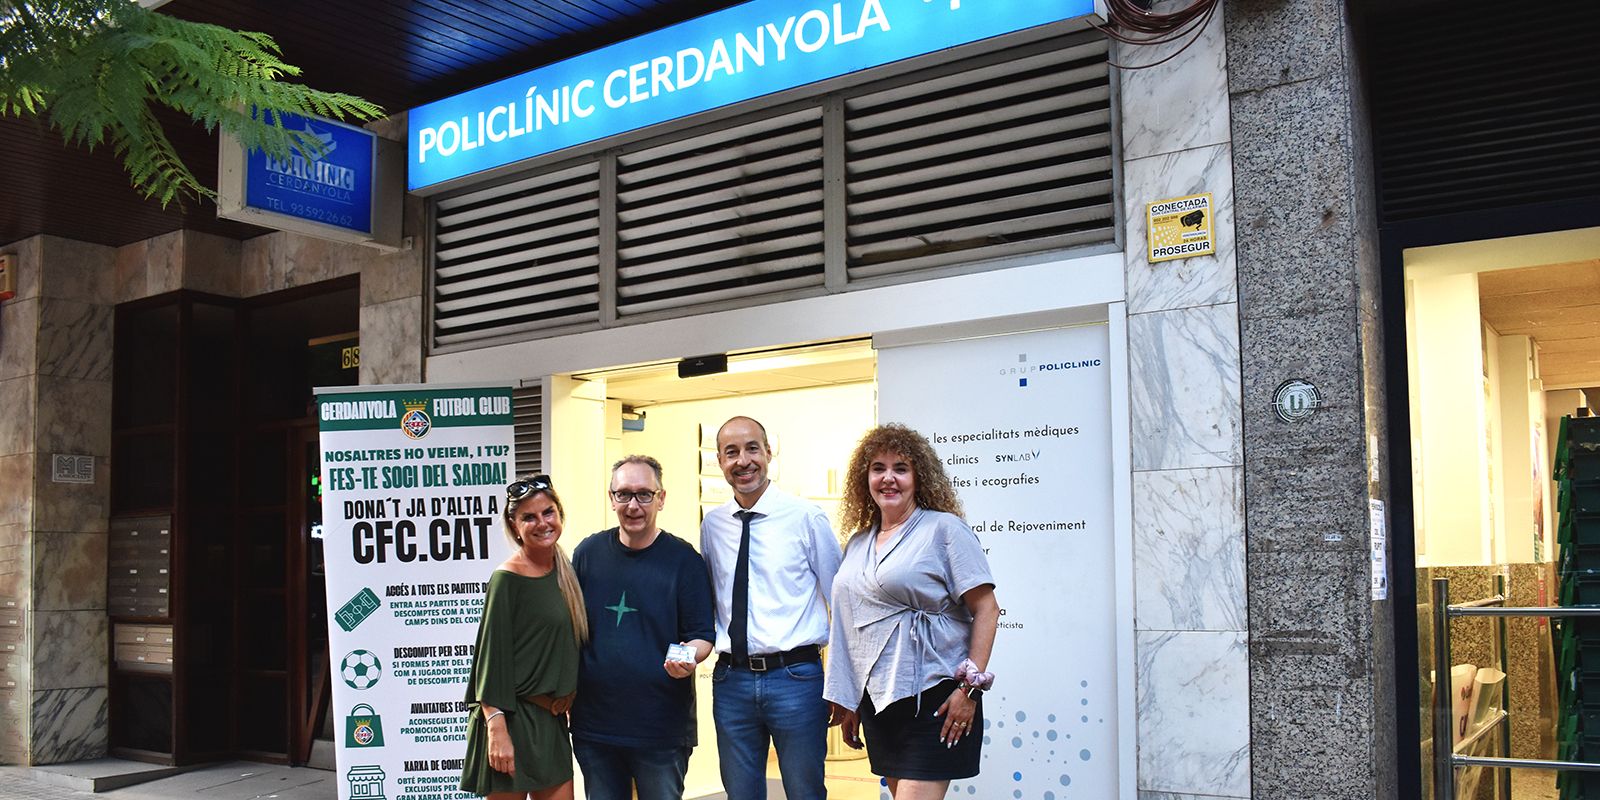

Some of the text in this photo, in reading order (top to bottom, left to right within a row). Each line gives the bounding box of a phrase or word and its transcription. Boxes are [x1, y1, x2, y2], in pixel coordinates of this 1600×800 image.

[418, 0, 891, 164] POLICLÍNIC CERDANYOLA
[269, 172, 352, 201] CERDANYOLA
[266, 196, 353, 226] TEL. 93 592 26 62
[1151, 198, 1208, 213] CONECTADA
[1153, 241, 1210, 257] PROSEGUR
[343, 348, 360, 366] 68
[999, 365, 1036, 376] GRUP
[321, 396, 510, 421] CERDANYOLA FUTBOL CLUB
[933, 432, 948, 444] les
[951, 428, 1020, 444] especialitats
[325, 445, 510, 462] NOSALTRES HO VEIEM, I TU?
[995, 453, 1031, 463] SYNLAB
[329, 462, 507, 491] FES-TE SOCI DEL SARDA!
[981, 473, 1040, 489] ecografies
[406, 498, 426, 517] JA
[488, 495, 499, 515] A
[971, 519, 1086, 534] ral de Rejoveniment
[352, 517, 492, 564] CFC.CAT
[386, 582, 489, 597] ACCÉS A TOTS ELS PARTITS D
[390, 600, 413, 609] ENTRA
[414, 600, 428, 608] ALS
[429, 599, 458, 608] PARTITS
[471, 598, 484, 606] CAS
[394, 609, 440, 618] DESCOMPTES
[441, 608, 457, 616] COM
[405, 617, 429, 626] CAMPS
[430, 617, 449, 625] DINS
[394, 646, 437, 659] DESCOMPTE
[438, 645, 452, 657] PER
[454, 645, 468, 656] SER
[393, 661, 399, 669] SI
[401, 660, 430, 668] FORMES
[431, 659, 450, 667] PART
[394, 669, 410, 677] COM
[418, 668, 451, 676] JUGADOR
[407, 677, 417, 685] DE
[418, 676, 460, 685] DESCOMPTE
[410, 701, 468, 715] AVANTATGES ECO
[408, 716, 458, 725] ACONSEGUEIX
[400, 726, 448, 735] PROMOCIONS
[414, 734, 466, 743] BOTIGA OFICIA
[404, 760, 429, 772] XARXA
[431, 760, 440, 771] DE
[397, 775, 461, 785] OBTÉ PROMOCION
[405, 784, 457, 793] EXCLUSIUS PER
